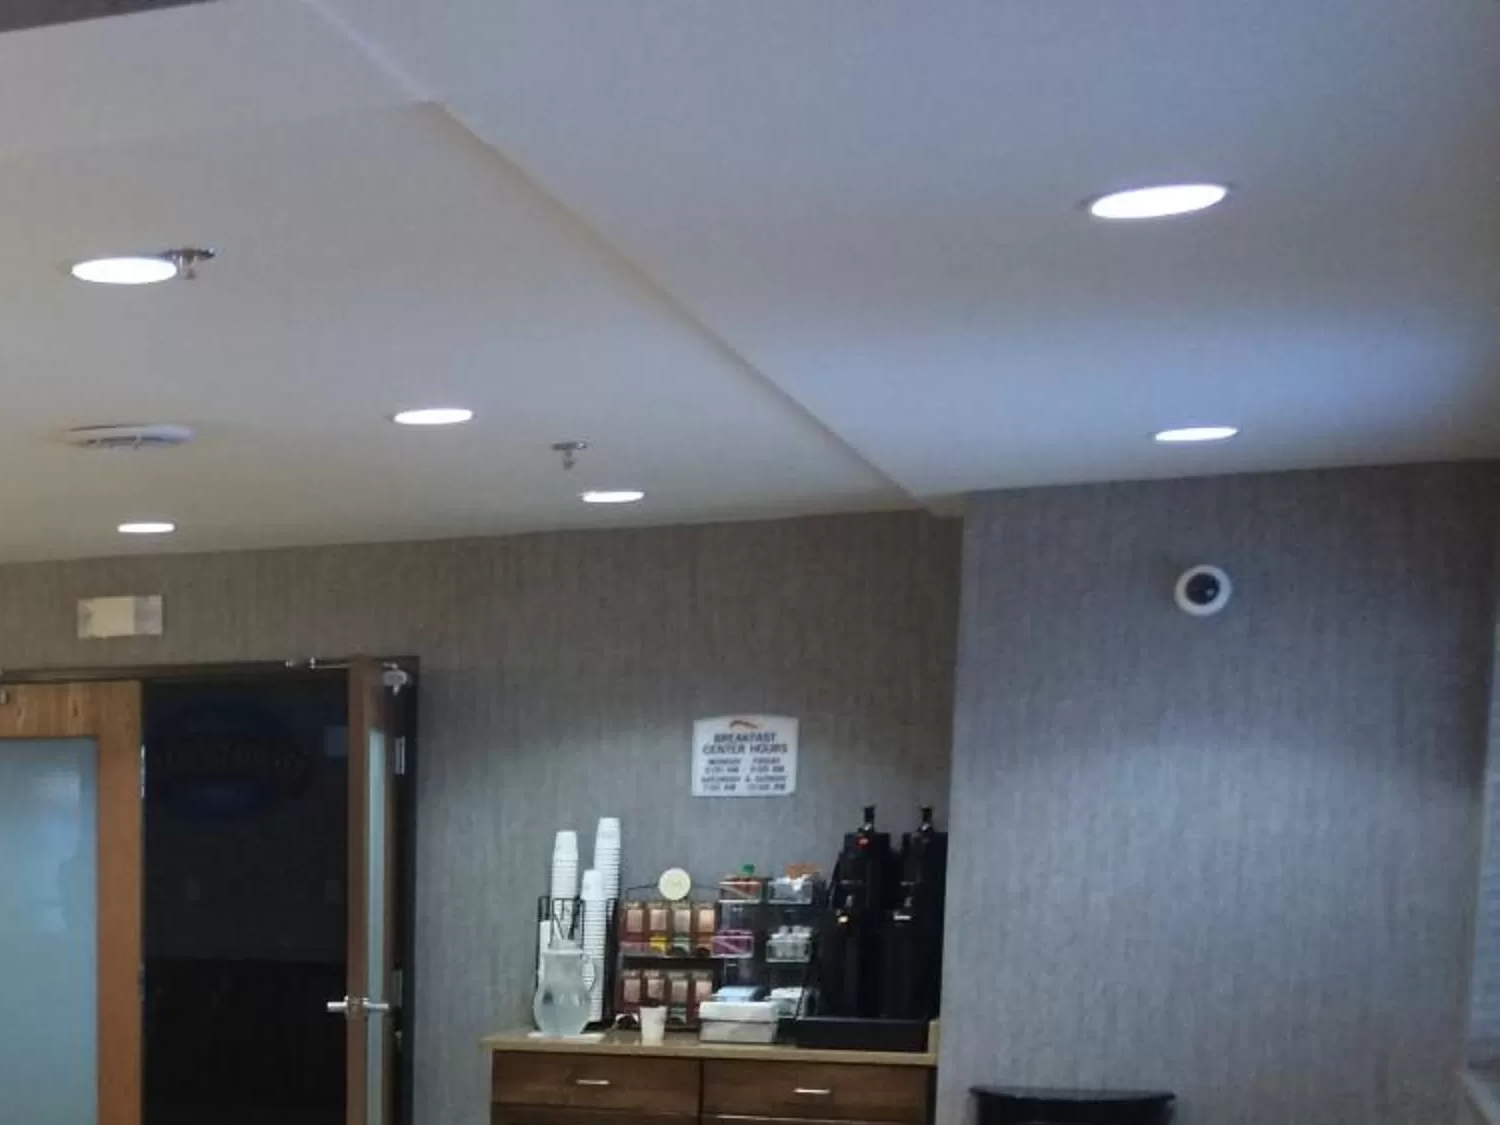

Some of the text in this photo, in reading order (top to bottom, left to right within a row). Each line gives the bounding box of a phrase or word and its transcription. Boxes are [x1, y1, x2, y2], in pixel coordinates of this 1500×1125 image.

[713, 732, 776, 743] BREAKFAST
[702, 743, 788, 754] CENTER HOURS
